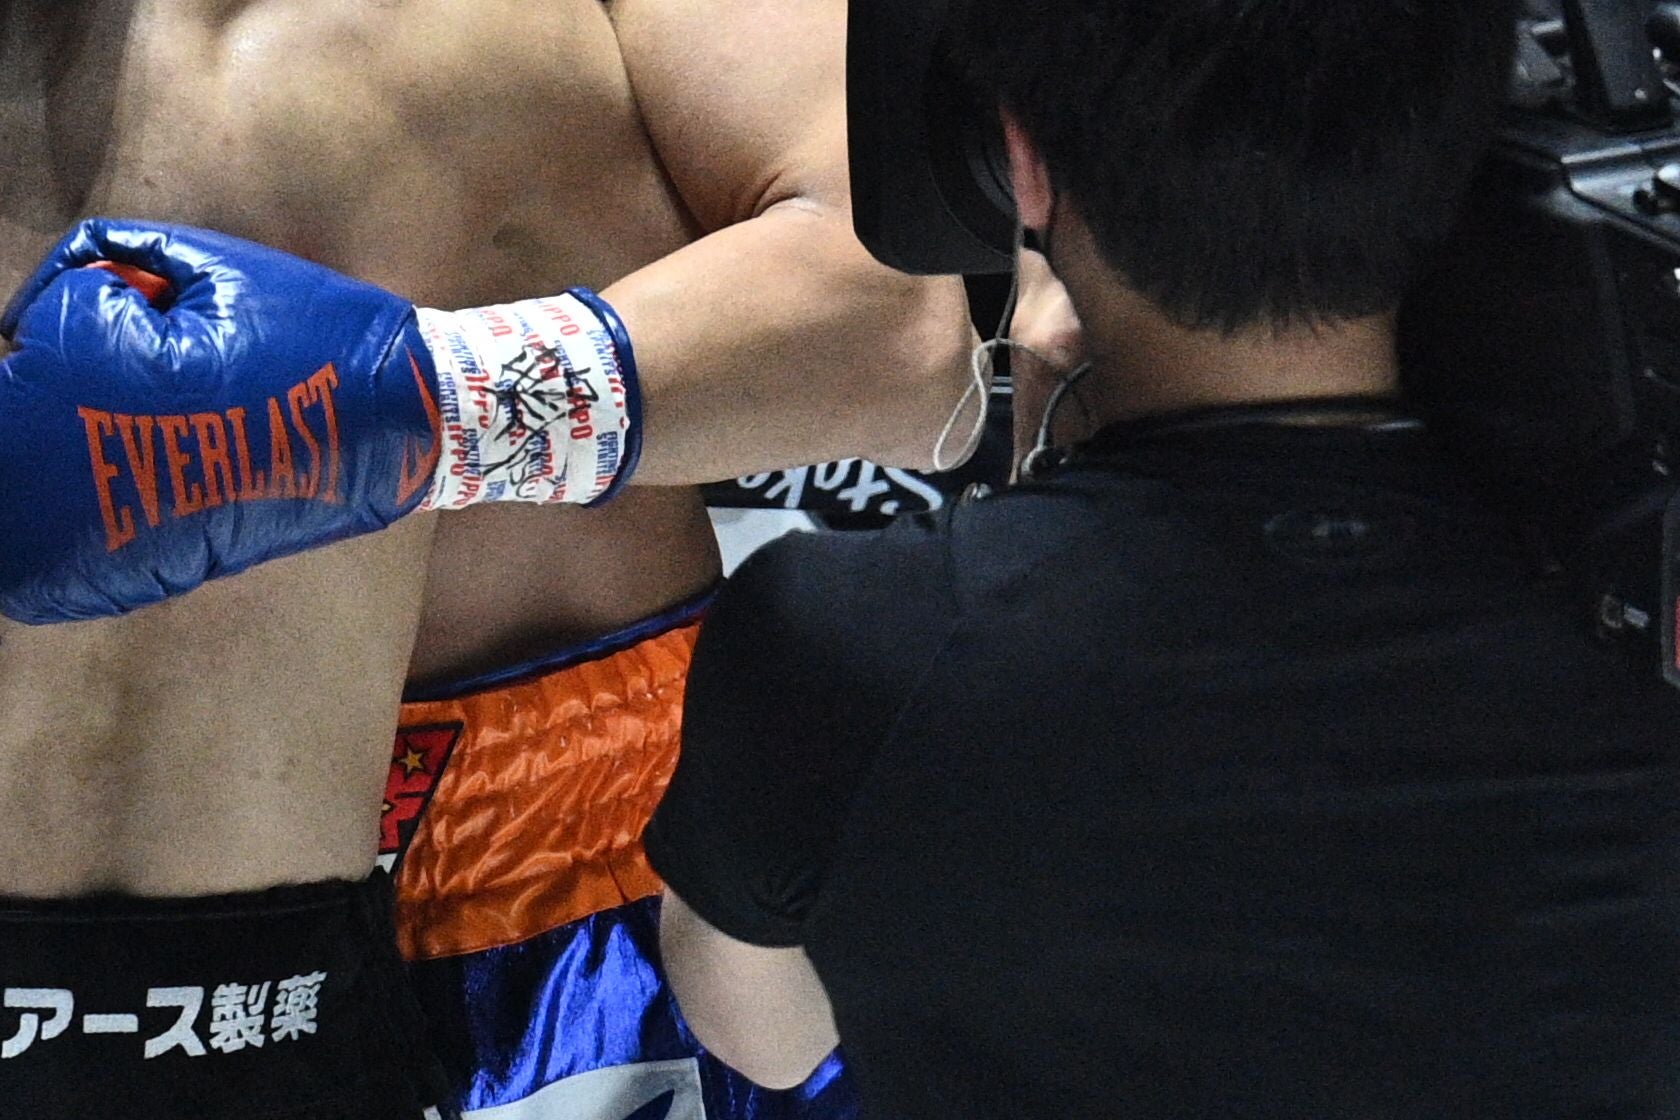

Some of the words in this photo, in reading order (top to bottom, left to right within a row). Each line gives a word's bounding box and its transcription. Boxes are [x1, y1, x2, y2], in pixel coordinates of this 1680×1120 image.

[77, 362, 339, 553] EVERLAST
[1, 970, 328, 1060] アース製薬
